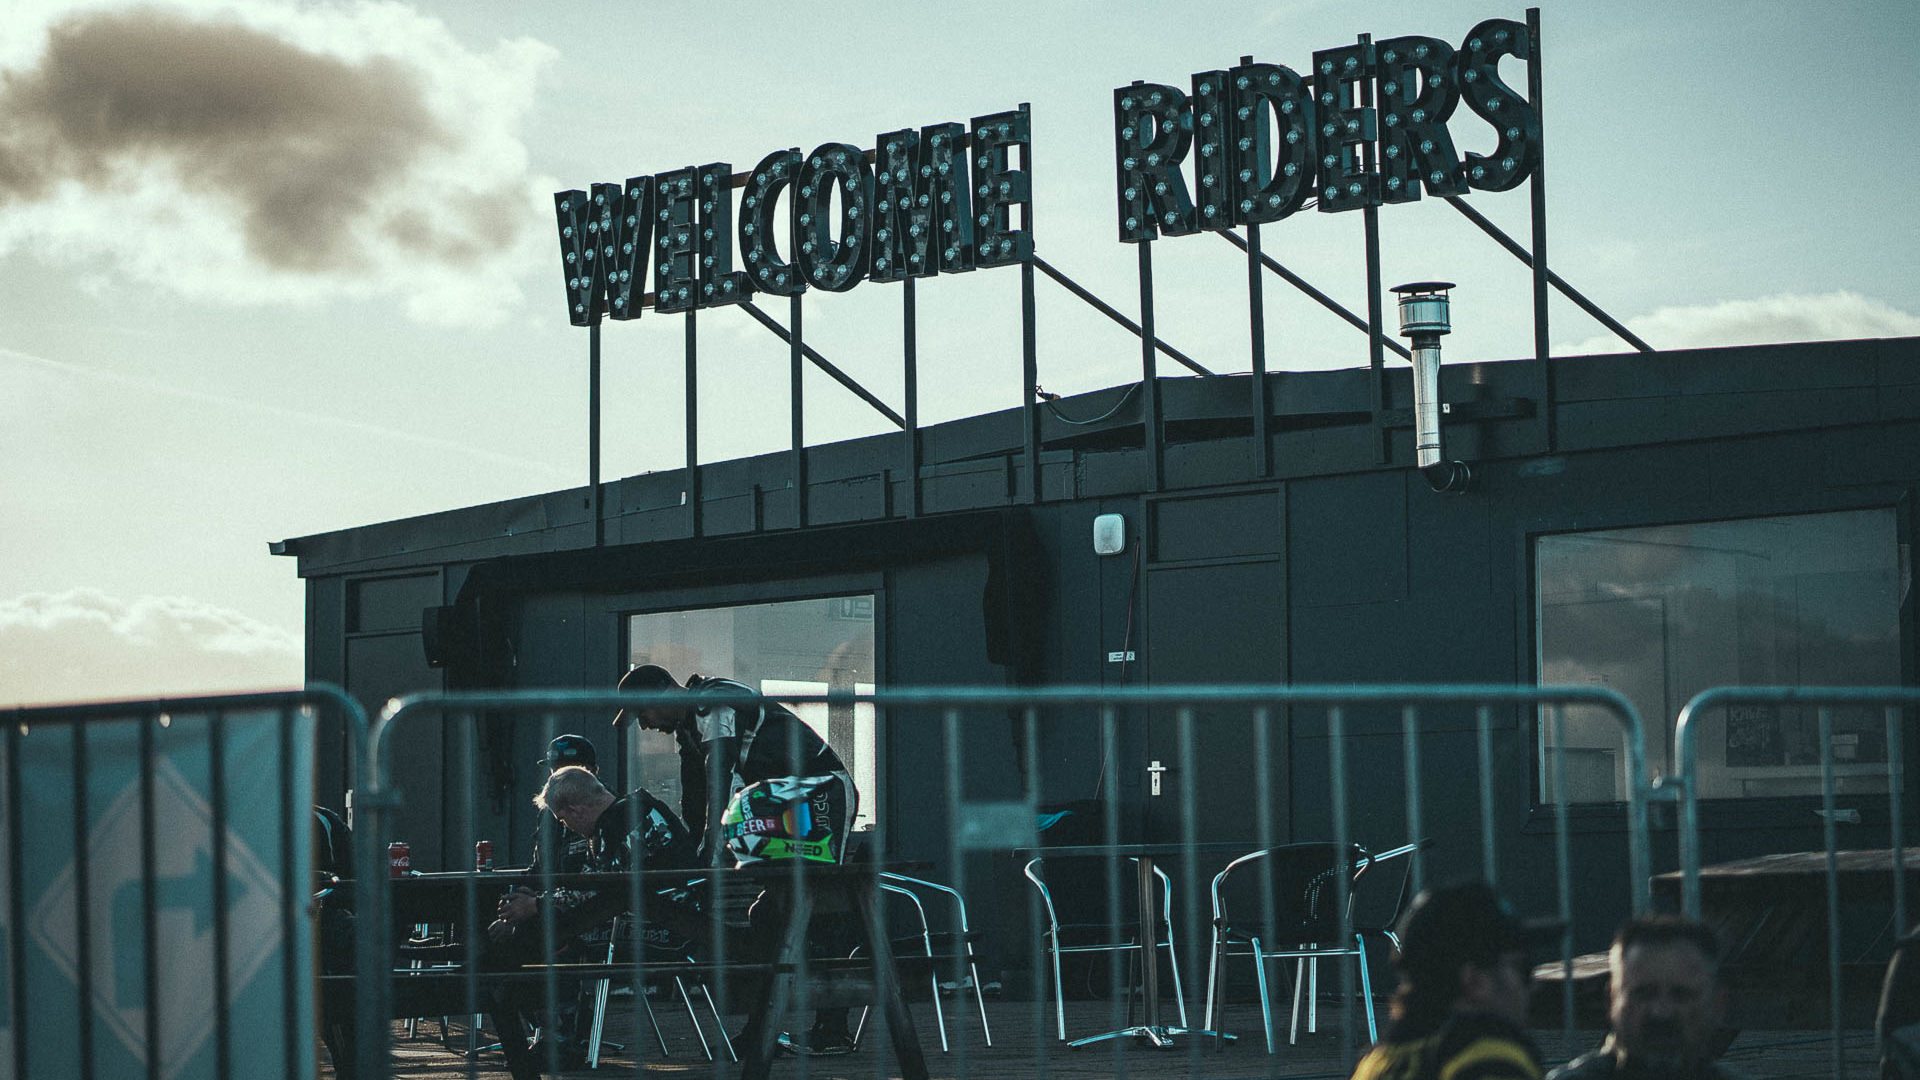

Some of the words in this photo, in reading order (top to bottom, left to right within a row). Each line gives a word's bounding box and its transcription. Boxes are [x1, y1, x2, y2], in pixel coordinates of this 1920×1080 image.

[554, 108, 1031, 326] WELCOME
[1113, 18, 1541, 243] RIDERS
[736, 819, 767, 837] BEER
